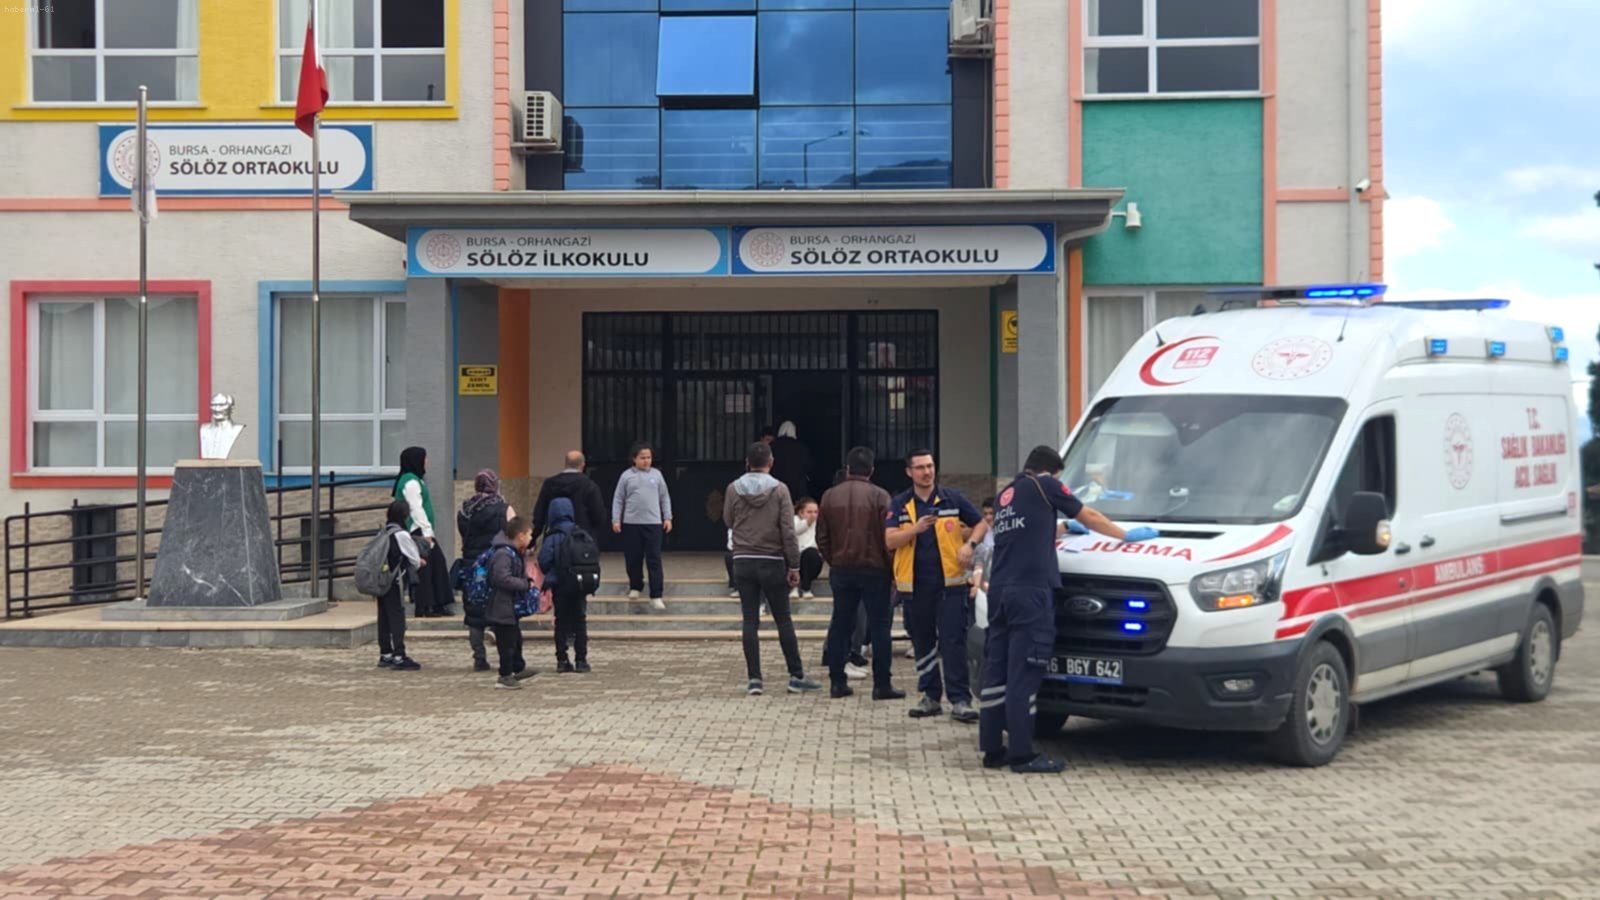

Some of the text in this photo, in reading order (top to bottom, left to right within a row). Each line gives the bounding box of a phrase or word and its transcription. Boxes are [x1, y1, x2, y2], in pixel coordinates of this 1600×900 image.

[169, 146, 209, 156] BURSA
[219, 145, 292, 155] ORHANGAZİ
[170, 159, 339, 175] SÖLÖZ ORTAOKULU
[466, 236, 507, 247] BURSA
[516, 235, 592, 247] ORHANGAZİ
[789, 234, 831, 246] BURSA
[841, 234, 916, 244] ORHANGAZİ
[467, 249, 649, 267] SÖLÖZ İLKOKULU
[791, 247, 1000, 264] SÖLÖZ ORTAOKULU
[1184, 348, 1211, 360] 112
[1066, 658, 1090, 676] BGY
[1096, 660, 1121, 678] 642
